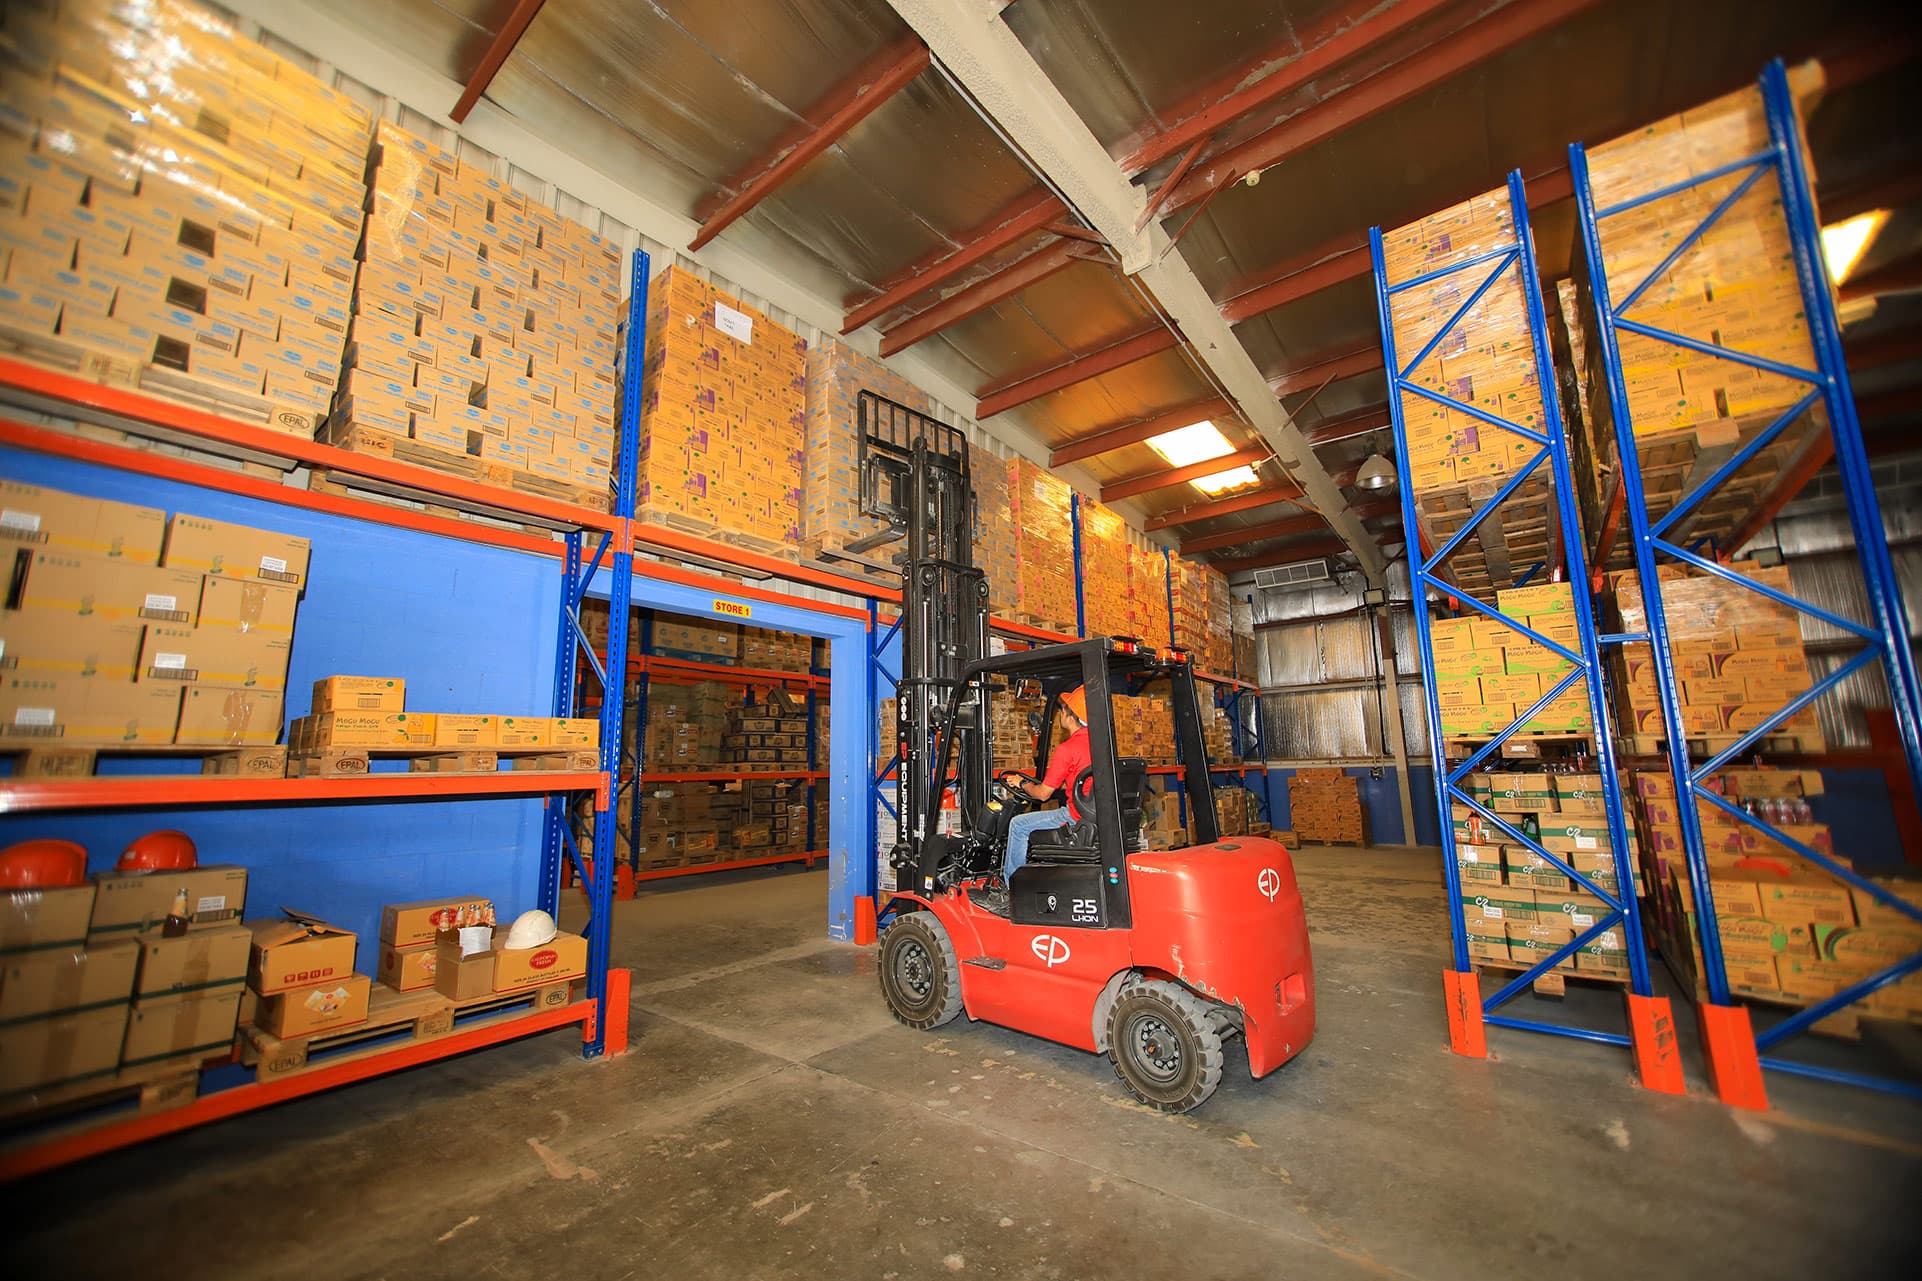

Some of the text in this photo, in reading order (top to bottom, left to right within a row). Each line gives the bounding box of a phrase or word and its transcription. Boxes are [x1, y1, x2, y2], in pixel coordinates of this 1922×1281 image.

[284, 414, 305, 426] EPAL
[715, 601, 750, 617] STORE 1
[253, 760, 275, 769] EPAL
[340, 760, 361, 770] EPAL
[1505, 790, 1516, 799] C2
[1566, 826, 1581, 838] C2
[1457, 860, 1467, 868] C2
[1591, 870, 1602, 879] C2
[1258, 868, 1280, 903] EP
[1072, 899, 1098, 914] 25
[1475, 896, 1489, 909] C2
[1562, 903, 1577, 915] C2
[1525, 940, 1537, 948] C2
[1031, 934, 1071, 968] EP
